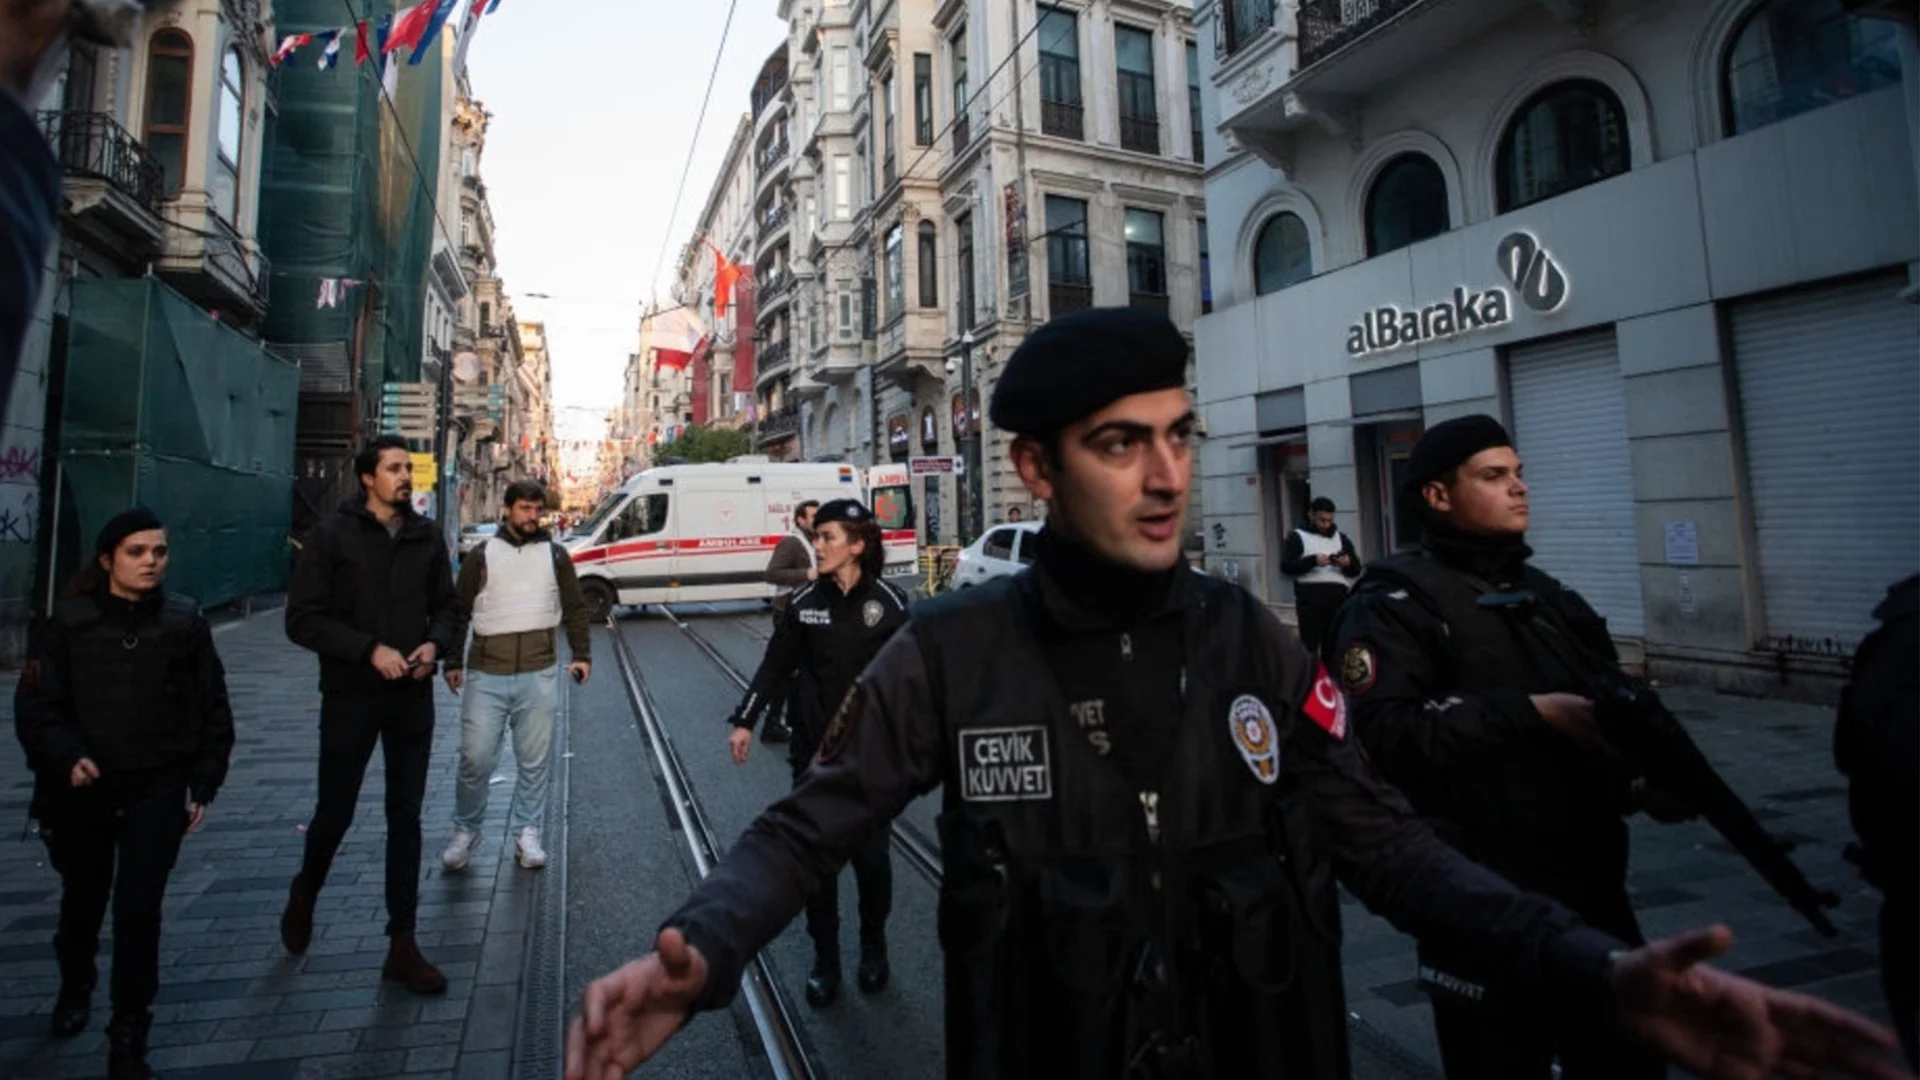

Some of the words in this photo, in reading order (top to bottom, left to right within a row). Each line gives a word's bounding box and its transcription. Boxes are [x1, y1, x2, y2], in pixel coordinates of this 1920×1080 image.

[1347, 286, 1509, 355] alBaraka
[974, 731, 1034, 764] ÇEVİK
[969, 765, 1045, 793] KUVVET
